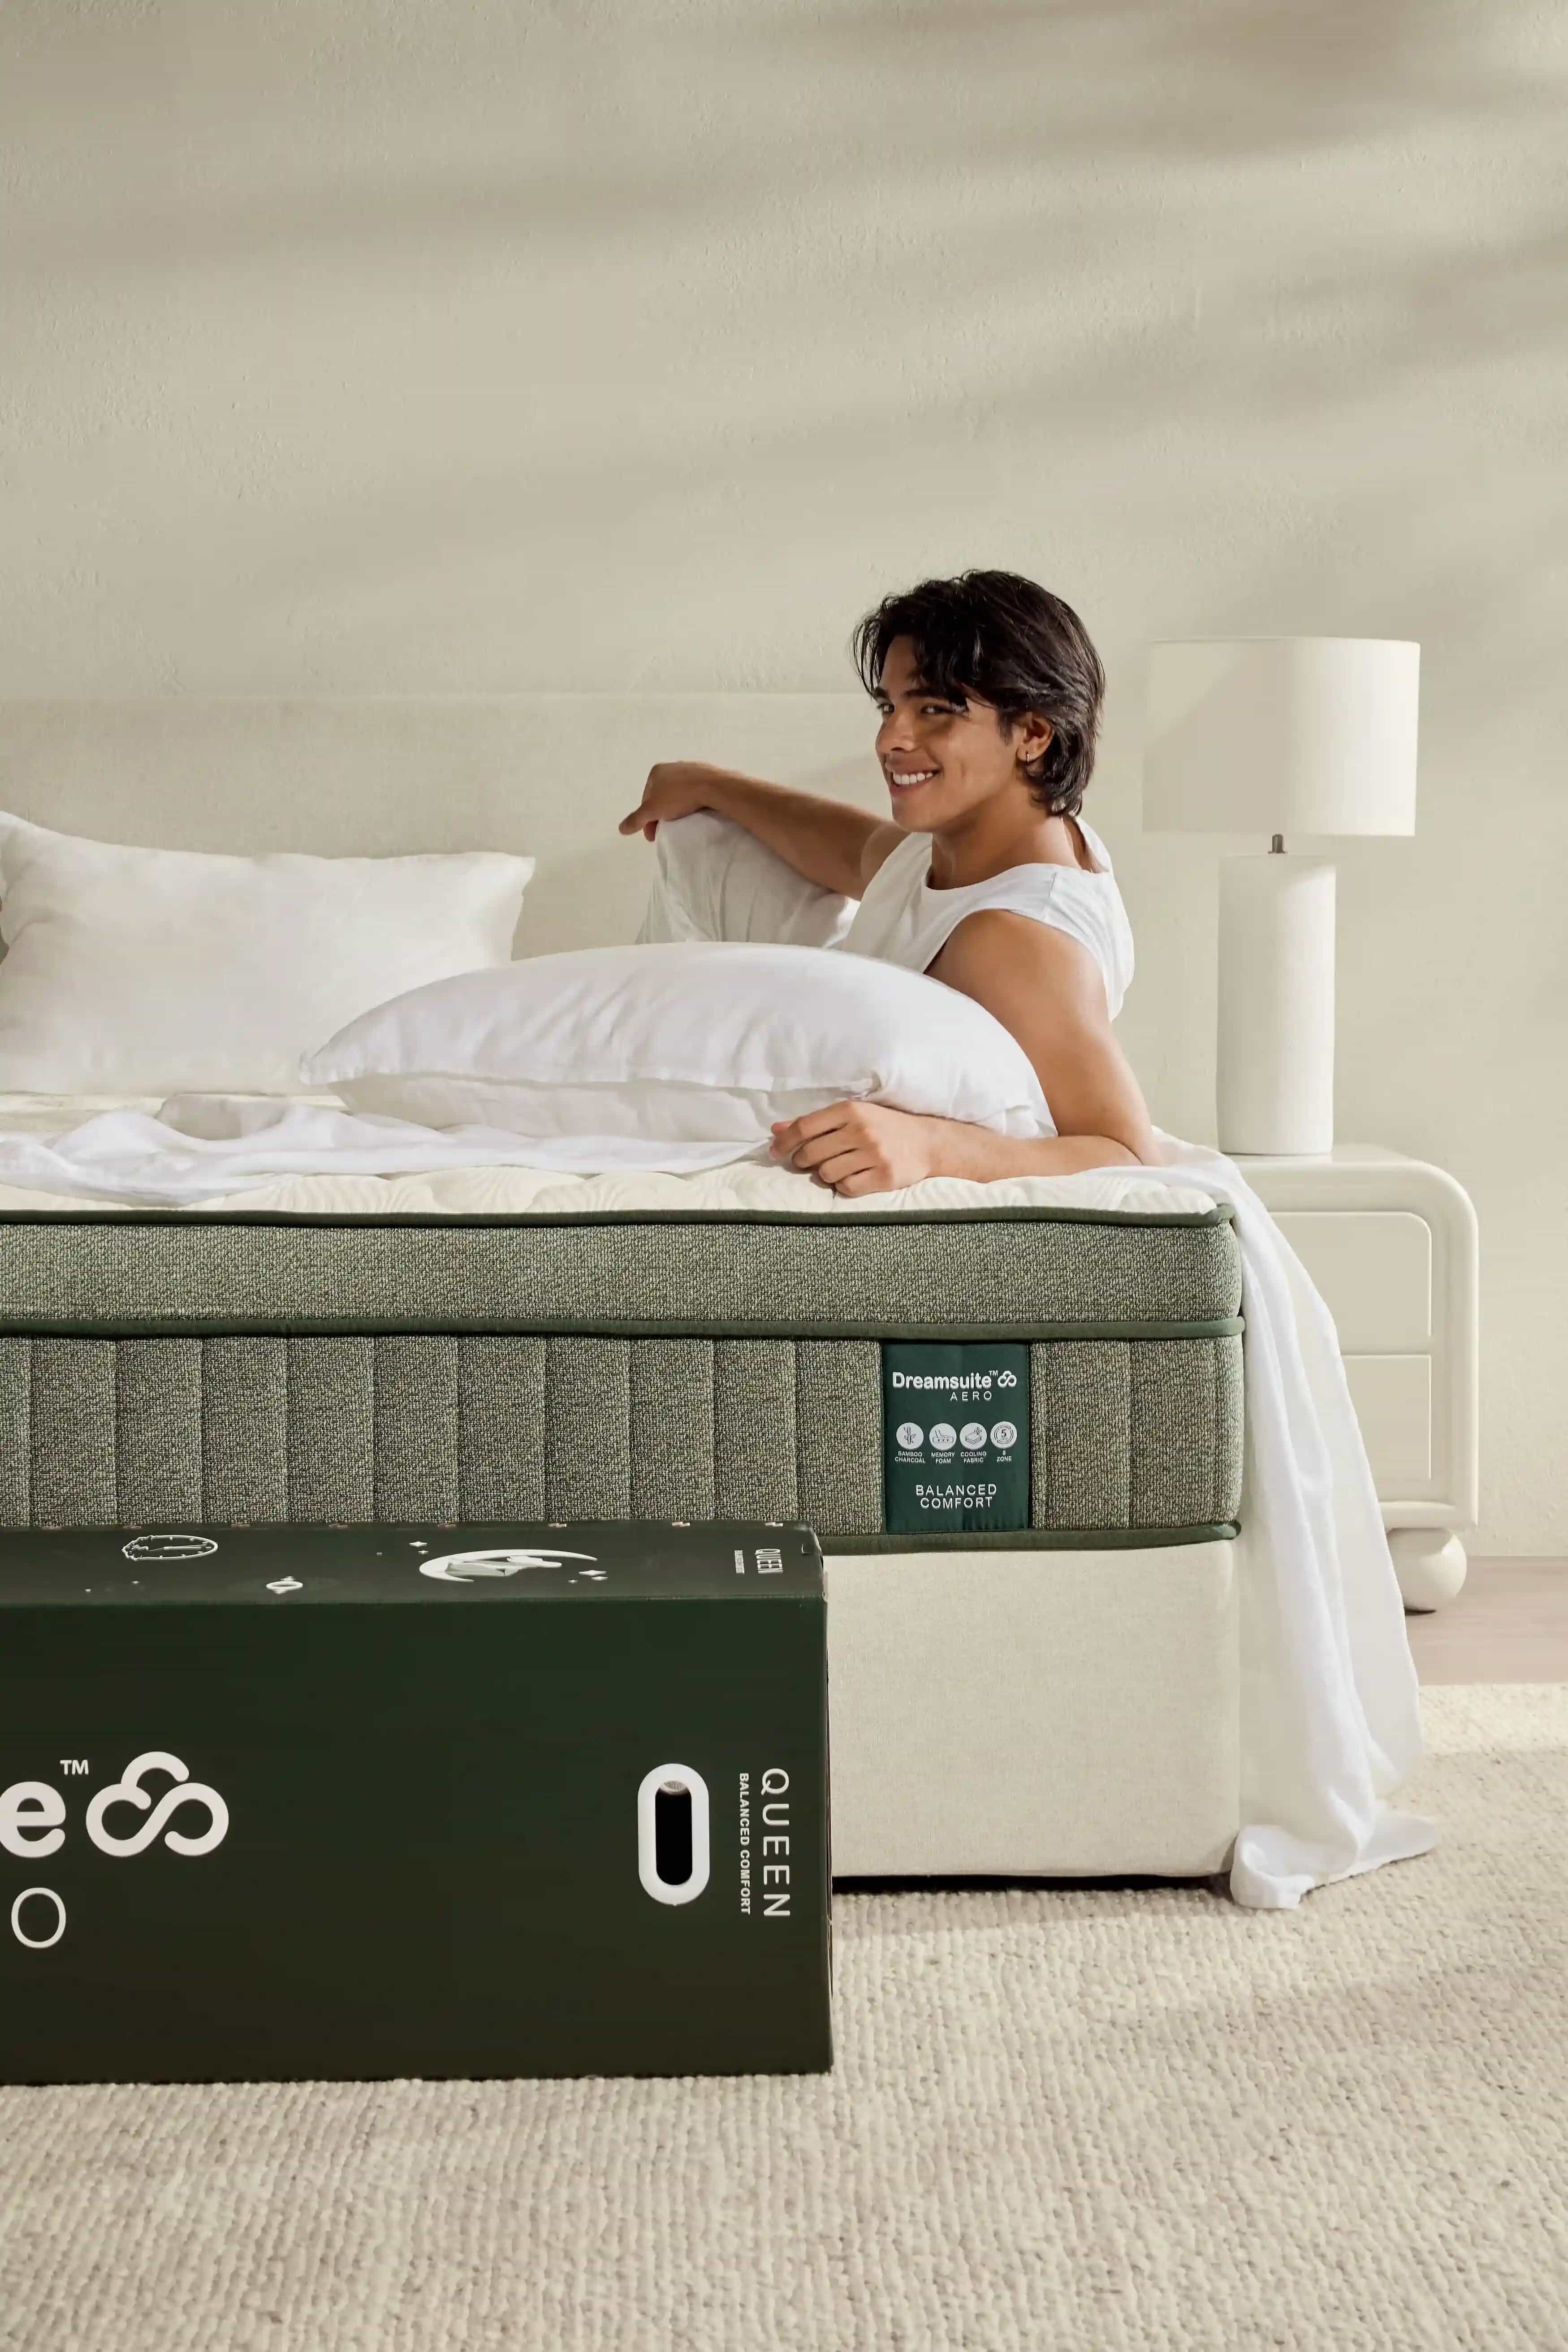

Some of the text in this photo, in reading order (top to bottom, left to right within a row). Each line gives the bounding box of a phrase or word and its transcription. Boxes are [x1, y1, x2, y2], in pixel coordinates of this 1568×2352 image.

[892, 1372, 992, 1389] Dreamsuite
[950, 1391, 992, 1401] AERO
[916, 1484, 997, 1497] BALANCED
[920, 1497, 993, 1509] COMFORT
[755, 1549, 783, 1574] QUEEN
[739, 1773, 750, 1915] BALANCED COMFORT
[761, 1768, 790, 1916] QUEEN
